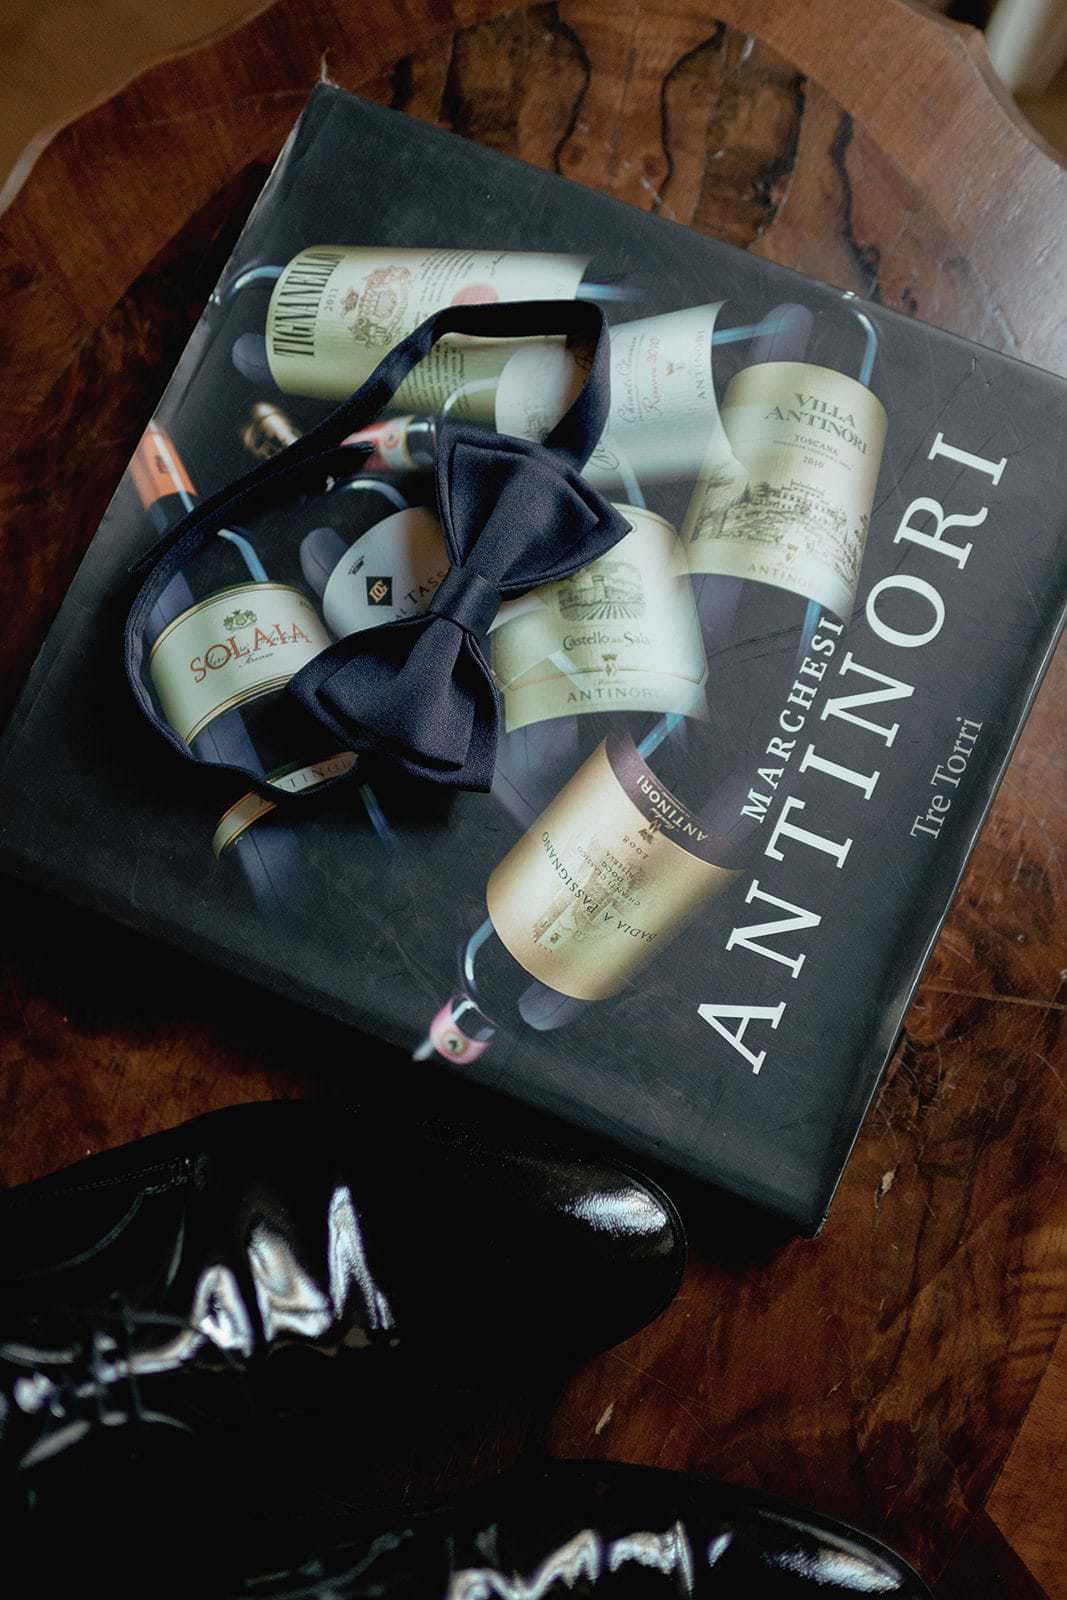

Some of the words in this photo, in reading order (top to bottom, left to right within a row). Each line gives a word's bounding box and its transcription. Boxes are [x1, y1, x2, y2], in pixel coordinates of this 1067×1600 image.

[273, 253, 346, 358] TIGNANELLO
[764, 406, 867, 455] ANTINORI
[794, 393, 856, 428] VILLA
[189, 623, 313, 683] SOLAIA
[563, 631, 610, 651] Castello
[740, 617, 844, 824] MARCHESI
[697, 432, 1008, 1074] ANTINORI
[930, 715, 984, 792] Torri
[635, 774, 709, 842] ANTINORI
[910, 795, 951, 840] Tre
[541, 831, 599, 915] PASSIGNANO
[603, 912, 612, 922] A
[616, 919, 658, 944] BADIA
